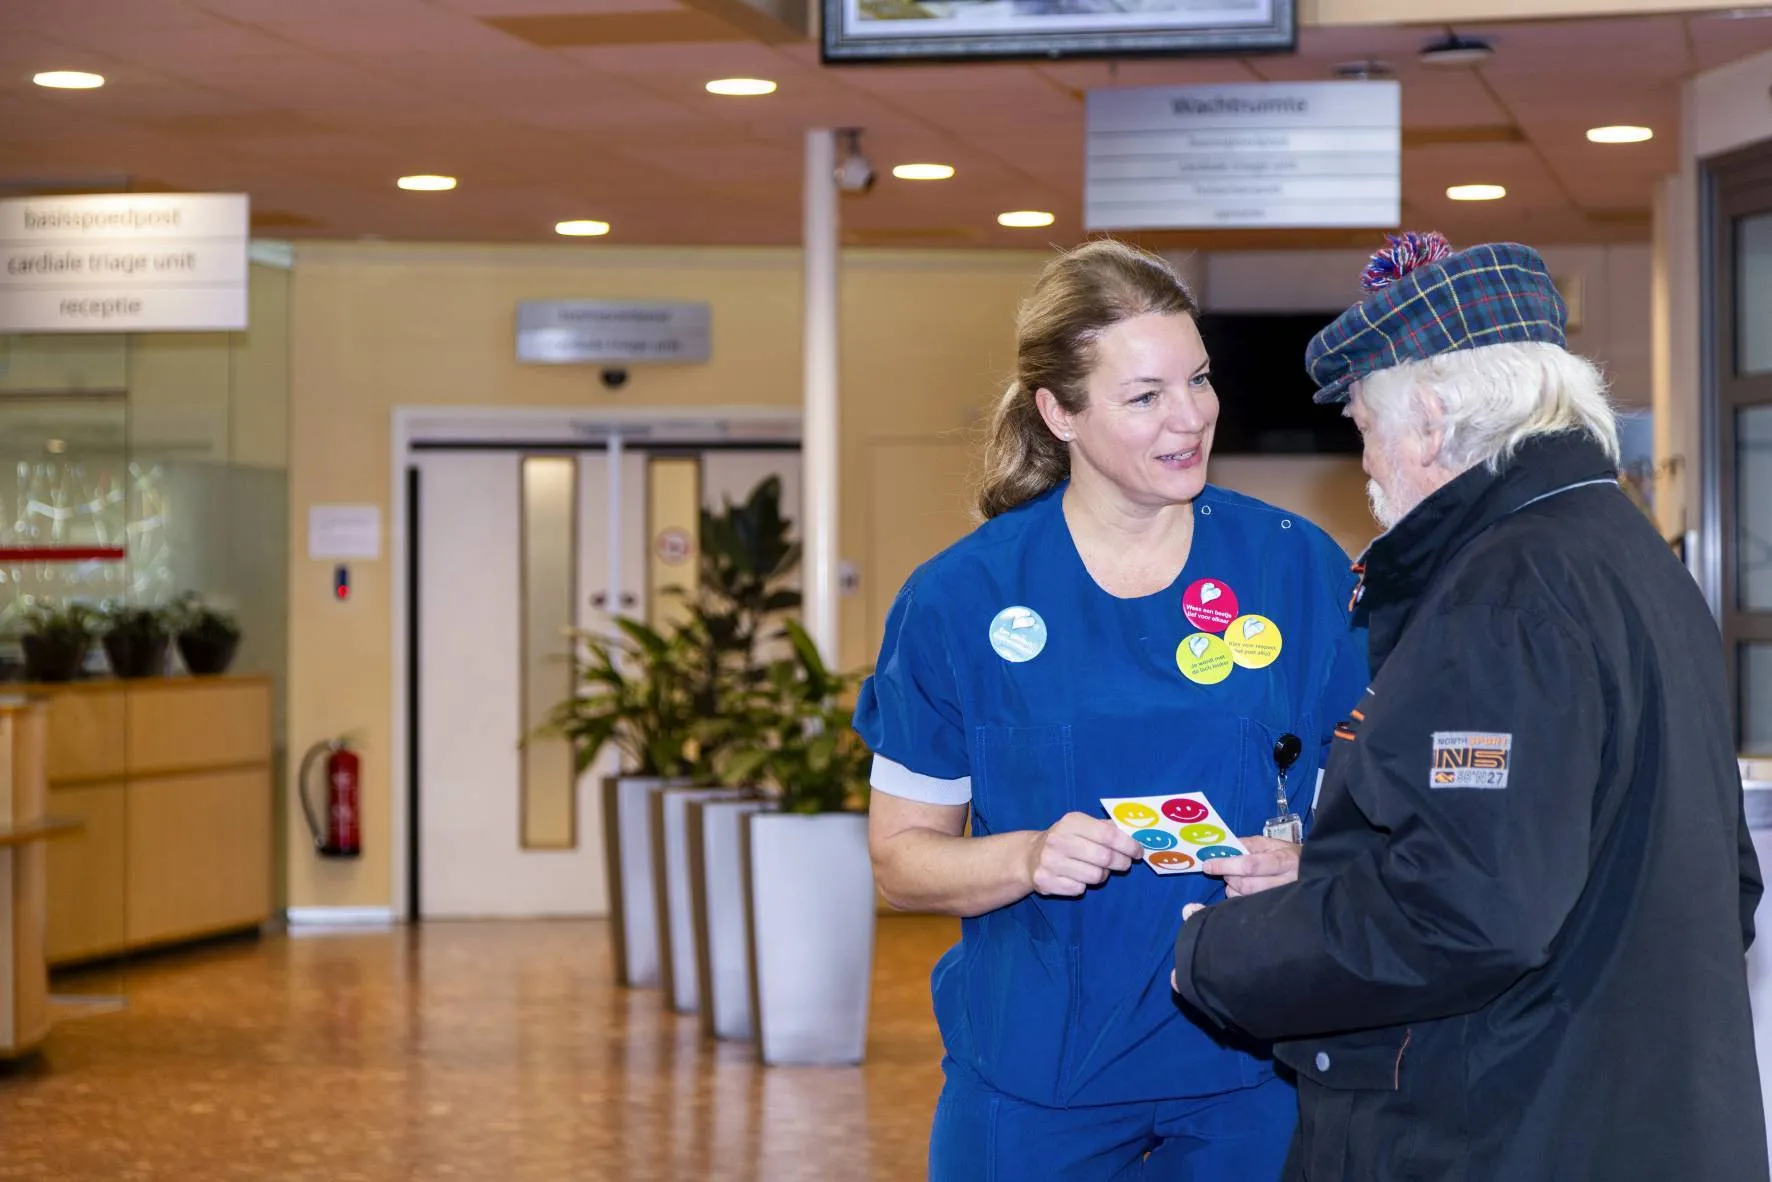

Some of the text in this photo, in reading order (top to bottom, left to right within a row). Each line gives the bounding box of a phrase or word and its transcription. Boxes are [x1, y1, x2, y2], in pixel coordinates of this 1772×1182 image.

[23, 206, 181, 231] basisspoedpost
[7, 251, 196, 276] cardiale triage unit
[59, 294, 142, 318] receptie
[1186, 604, 1202, 612] Wees
[1214, 609, 1232, 619] beetje
[1197, 613, 1211, 621] voor
[1211, 616, 1229, 624] elkaar
[1439, 735, 1508, 746] NORTH SPORT
[1434, 746, 1505, 769] NS
